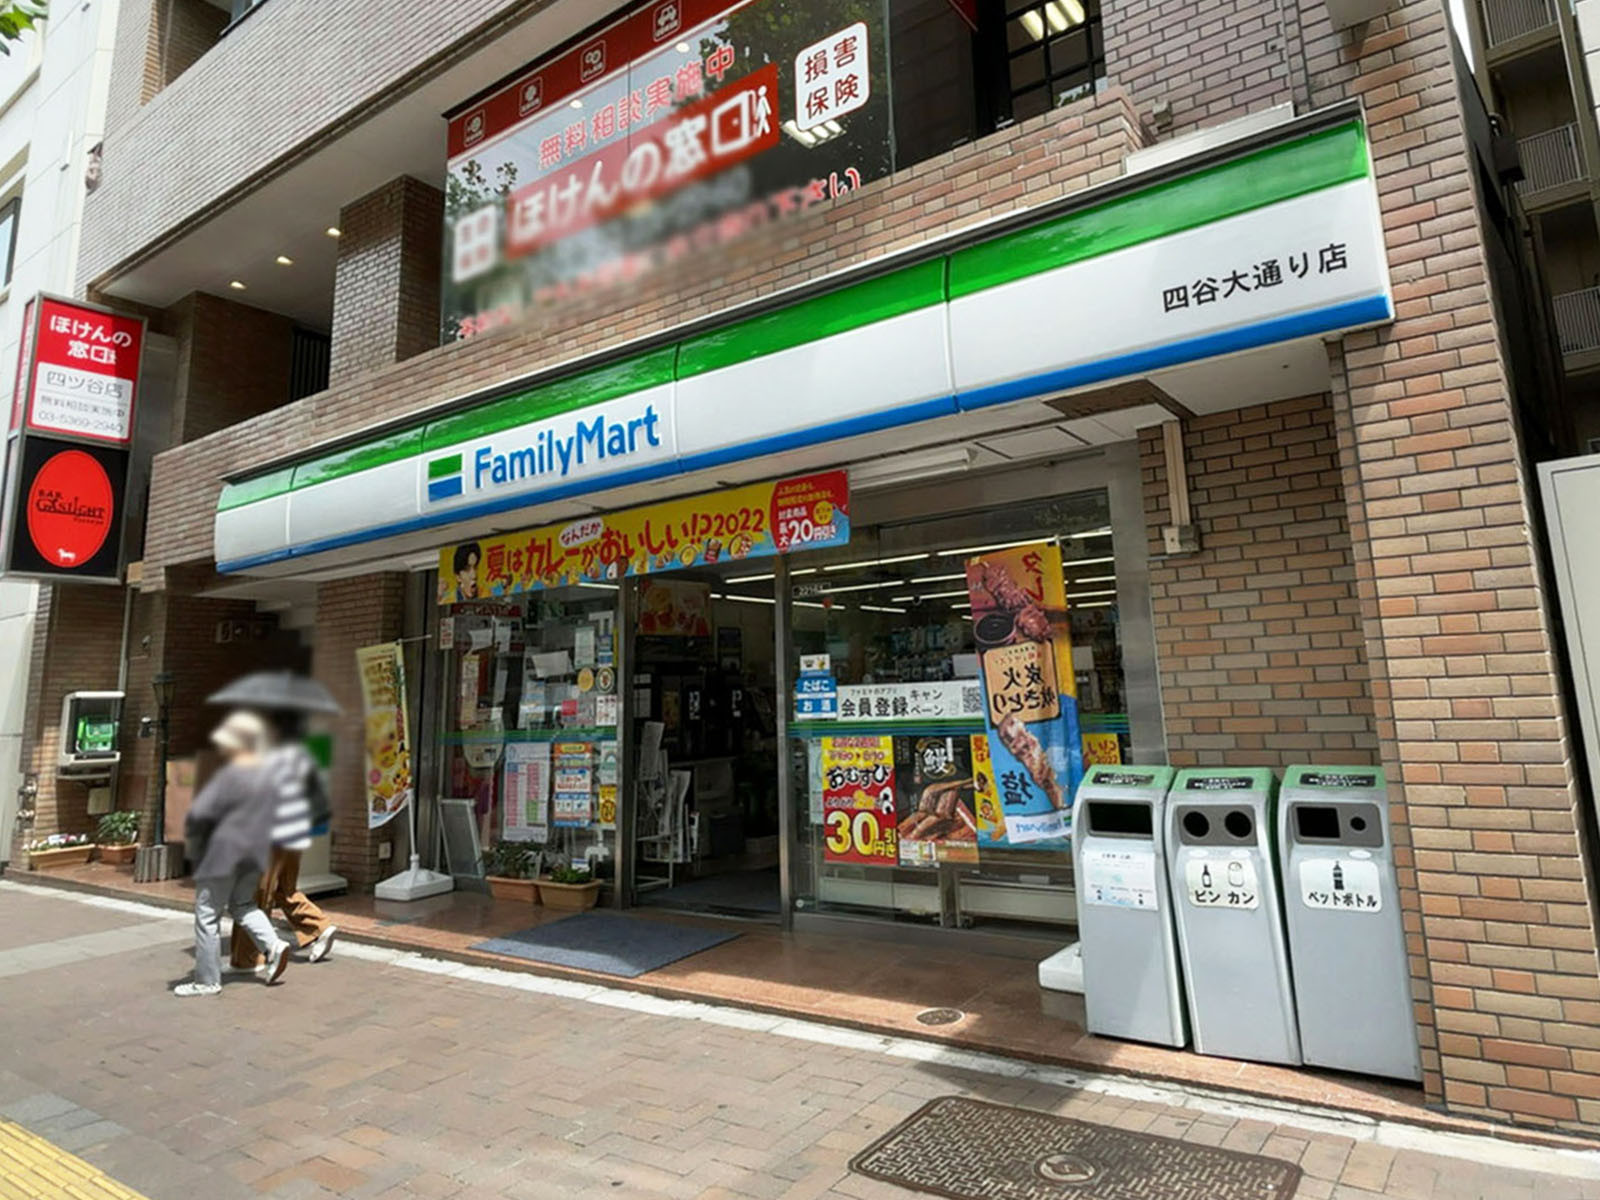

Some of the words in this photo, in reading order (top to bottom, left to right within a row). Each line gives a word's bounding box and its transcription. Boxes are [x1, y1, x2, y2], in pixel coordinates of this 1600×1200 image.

[804, 35, 859, 84] 損害
[538, 45, 735, 167] 無料相談実施中
[805, 78, 860, 116] 保険
[1163, 243, 1347, 313] 四谷大通り店
[50, 315, 132, 348] ほけんの
[47, 371, 123, 399] 四ツ谷店
[475, 404, 660, 489] FamilyMart
[560, 521, 602, 546] なんだか
[803, 679, 831, 692] たばこ
[910, 689, 943, 701] キャン
[841, 696, 909, 718] 会員登録
[910, 705, 945, 716] ペーン
[827, 764, 891, 790] おむすび
[1227, 891, 1255, 905] カン
[1307, 892, 1378, 908] ペットボトル
